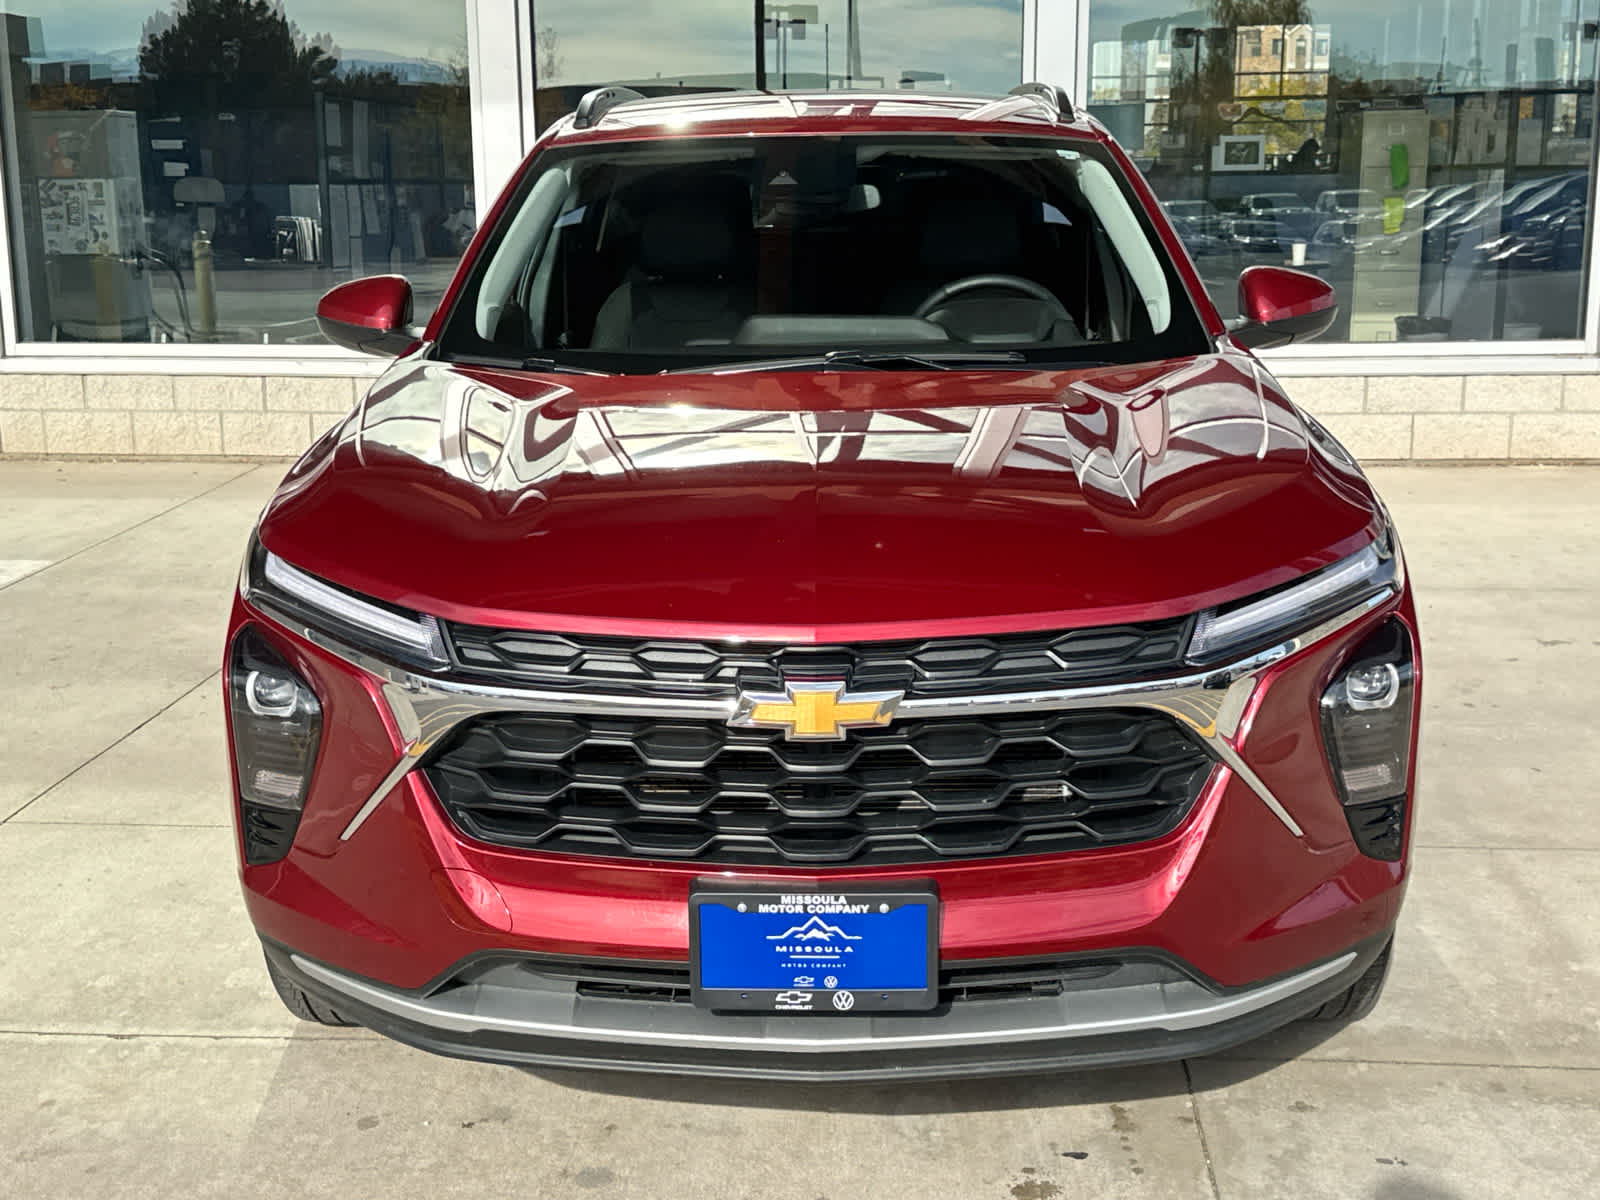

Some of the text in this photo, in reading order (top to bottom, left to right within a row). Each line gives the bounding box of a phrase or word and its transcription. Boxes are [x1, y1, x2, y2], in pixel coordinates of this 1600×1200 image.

[781, 895, 847, 904] MISSOULA
[758, 904, 869, 913] MOTOR COMPANY
